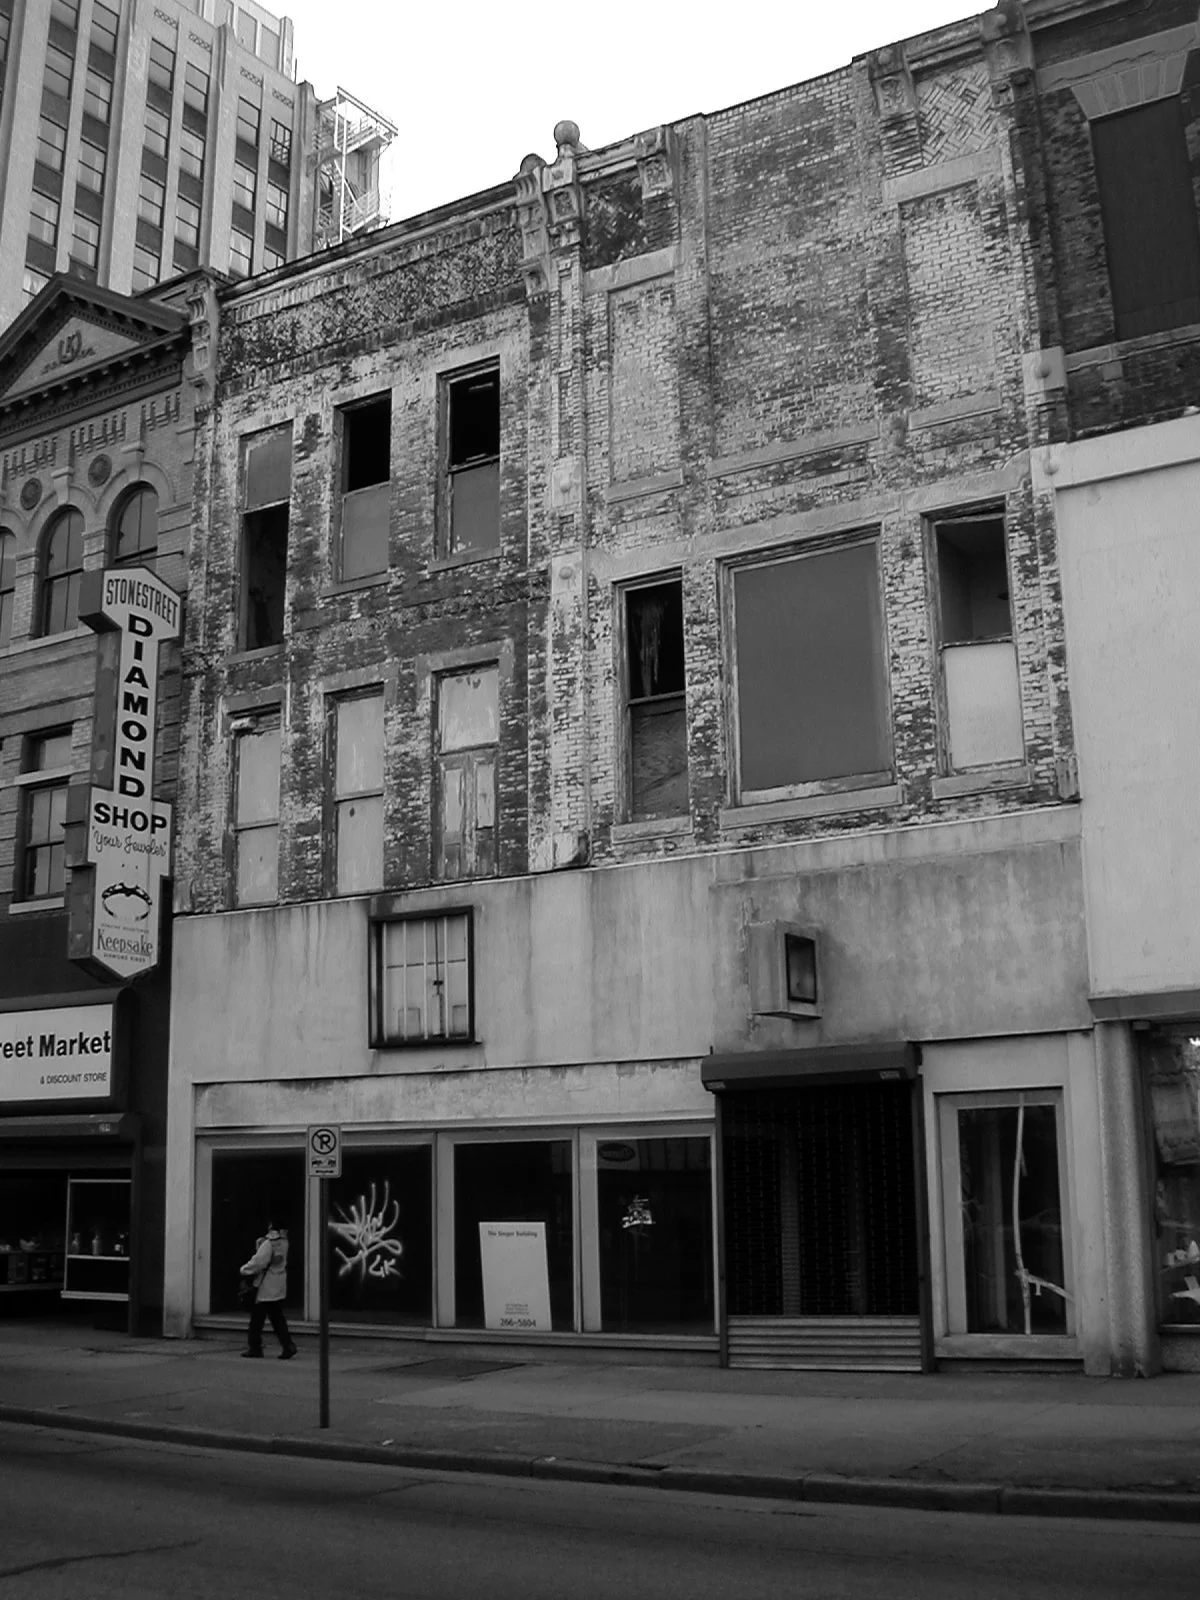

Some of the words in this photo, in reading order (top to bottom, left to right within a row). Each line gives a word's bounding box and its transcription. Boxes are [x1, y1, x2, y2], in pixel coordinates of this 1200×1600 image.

[106, 578, 178, 628] STONESTREET
[119, 613, 153, 798] DIAMOND
[93, 802, 167, 834] SHOP
[97, 927, 154, 955] Keepsake
[0, 1035, 34, 1059] reet
[39, 1030, 112, 1058] Market
[46, 1073, 82, 1085] DISCOUNT
[84, 1071, 108, 1083] STORE
